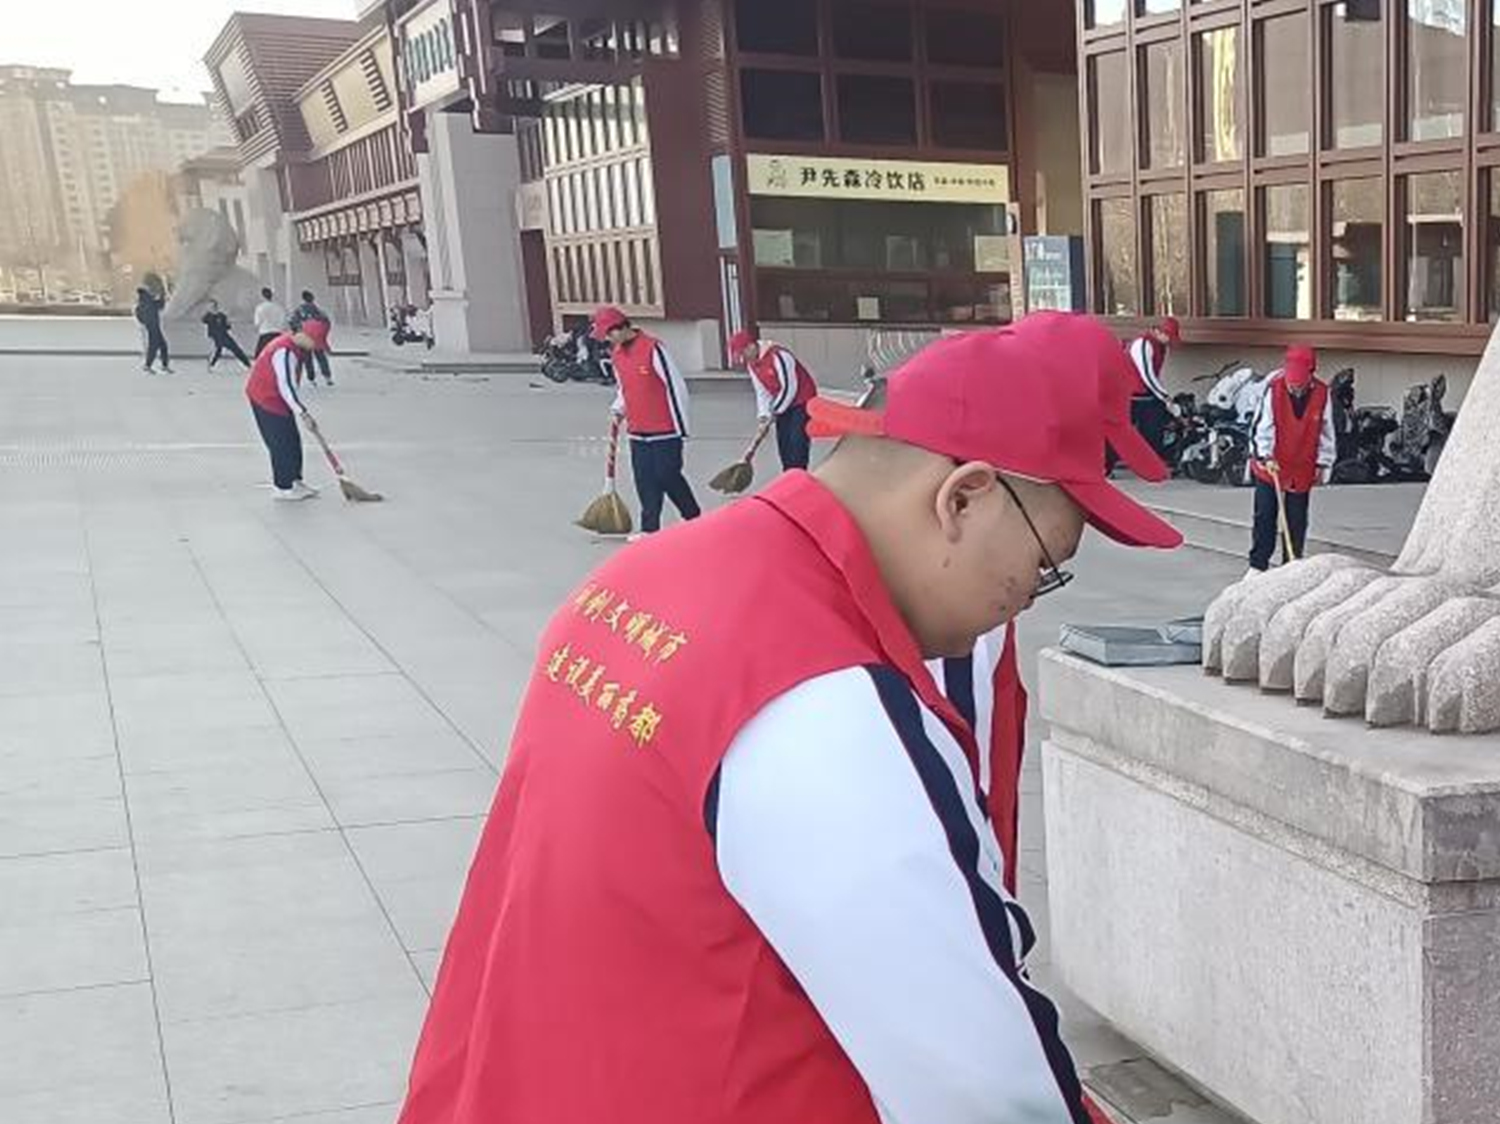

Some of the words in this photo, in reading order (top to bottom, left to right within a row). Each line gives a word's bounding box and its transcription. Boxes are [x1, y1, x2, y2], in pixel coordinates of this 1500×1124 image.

[800, 166, 926, 191] 尹先森冷饮店
